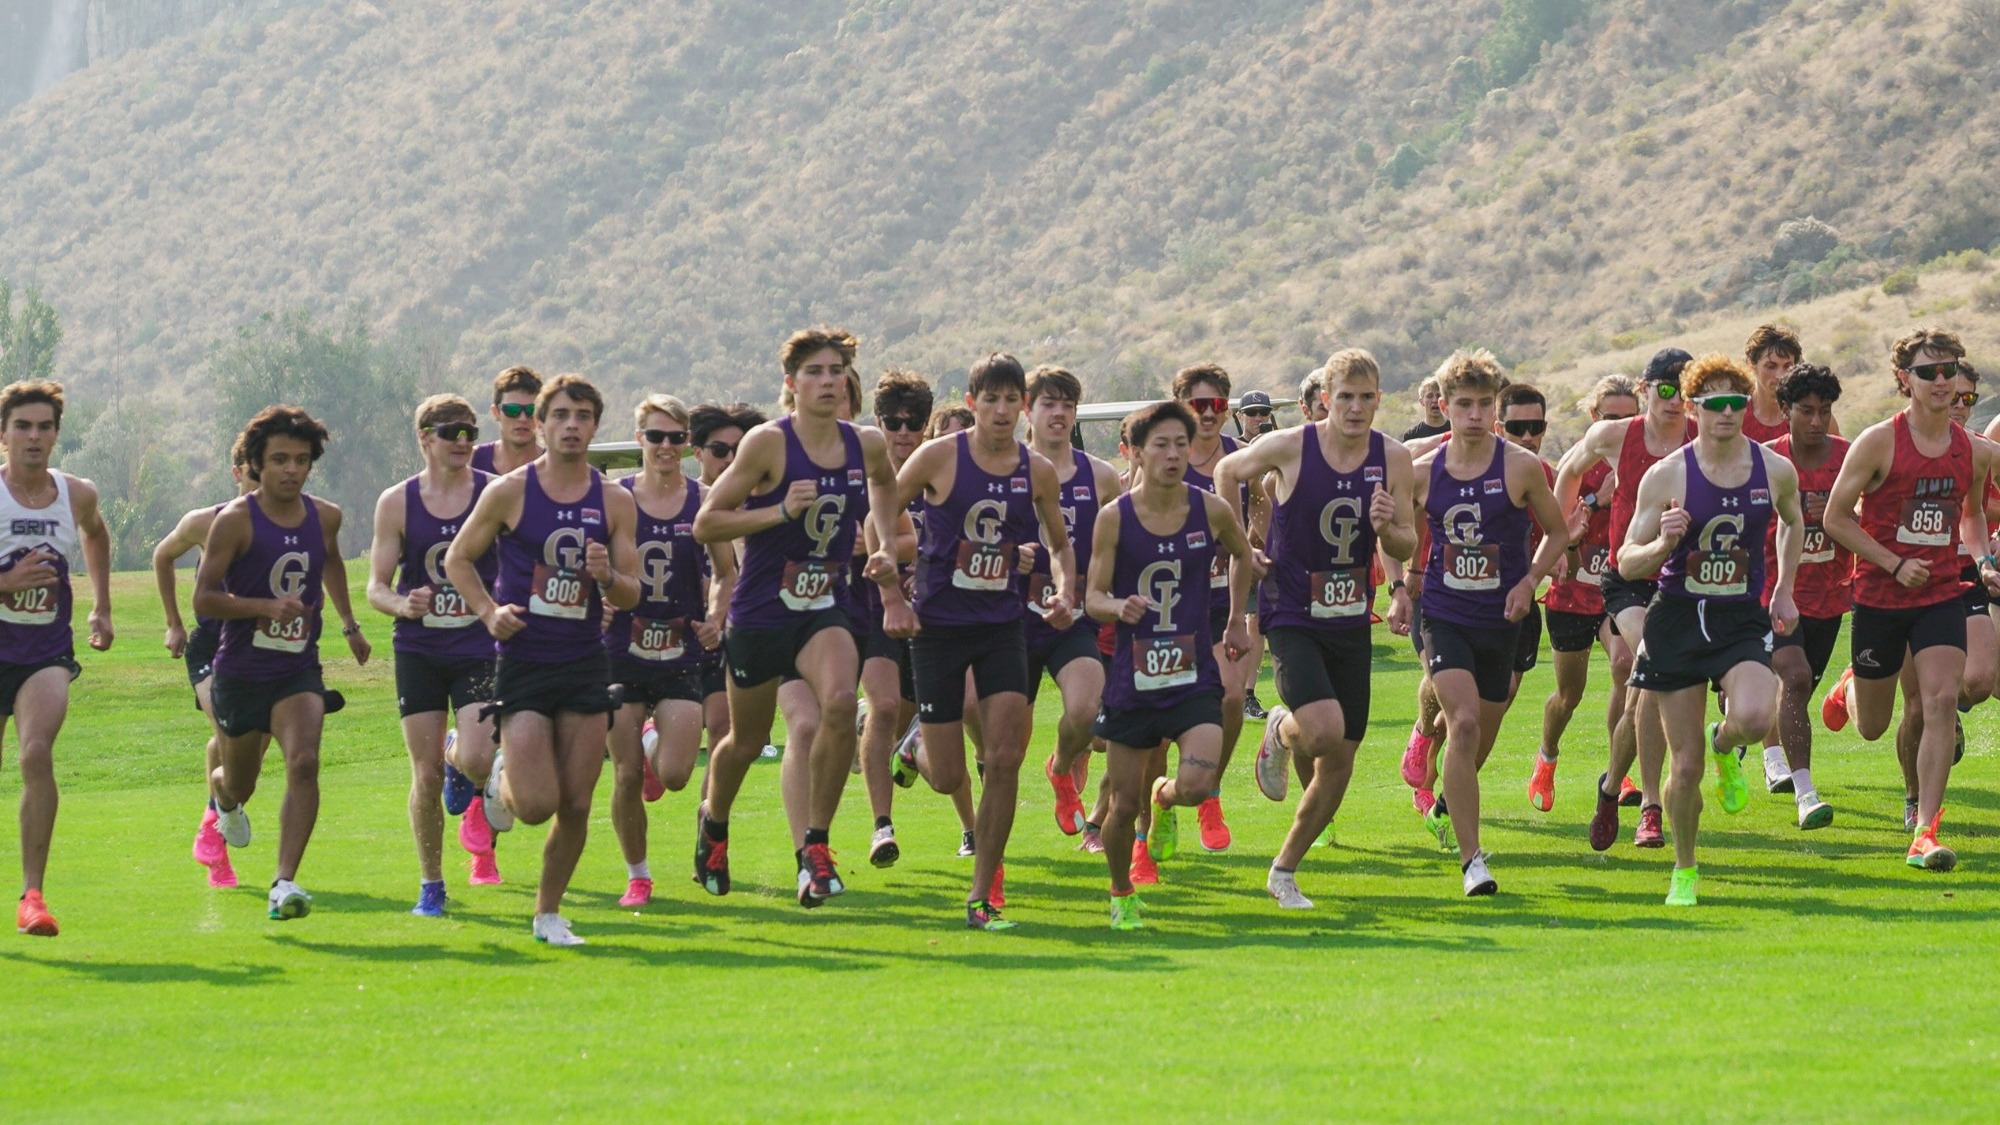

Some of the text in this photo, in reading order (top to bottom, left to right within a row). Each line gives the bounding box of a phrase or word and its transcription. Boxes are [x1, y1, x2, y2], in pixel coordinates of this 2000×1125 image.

[11, 519, 60, 536] GRIT
[1911, 510, 1943, 532] 858
[1804, 532, 1824, 551] 49
[969, 553, 1003, 577] 810
[1456, 555, 1488, 577] 802
[1590, 555, 1609, 573] 84
[1700, 561, 1736, 583] 809
[546, 577, 581, 604] 808
[795, 572, 828, 597] 837
[1324, 580, 1356, 604] 832
[14, 588, 48, 610] 902
[435, 593, 466, 615] 821
[270, 617, 304, 638] 833
[642, 629, 672, 648] 801
[1146, 647, 1183, 675] 822
